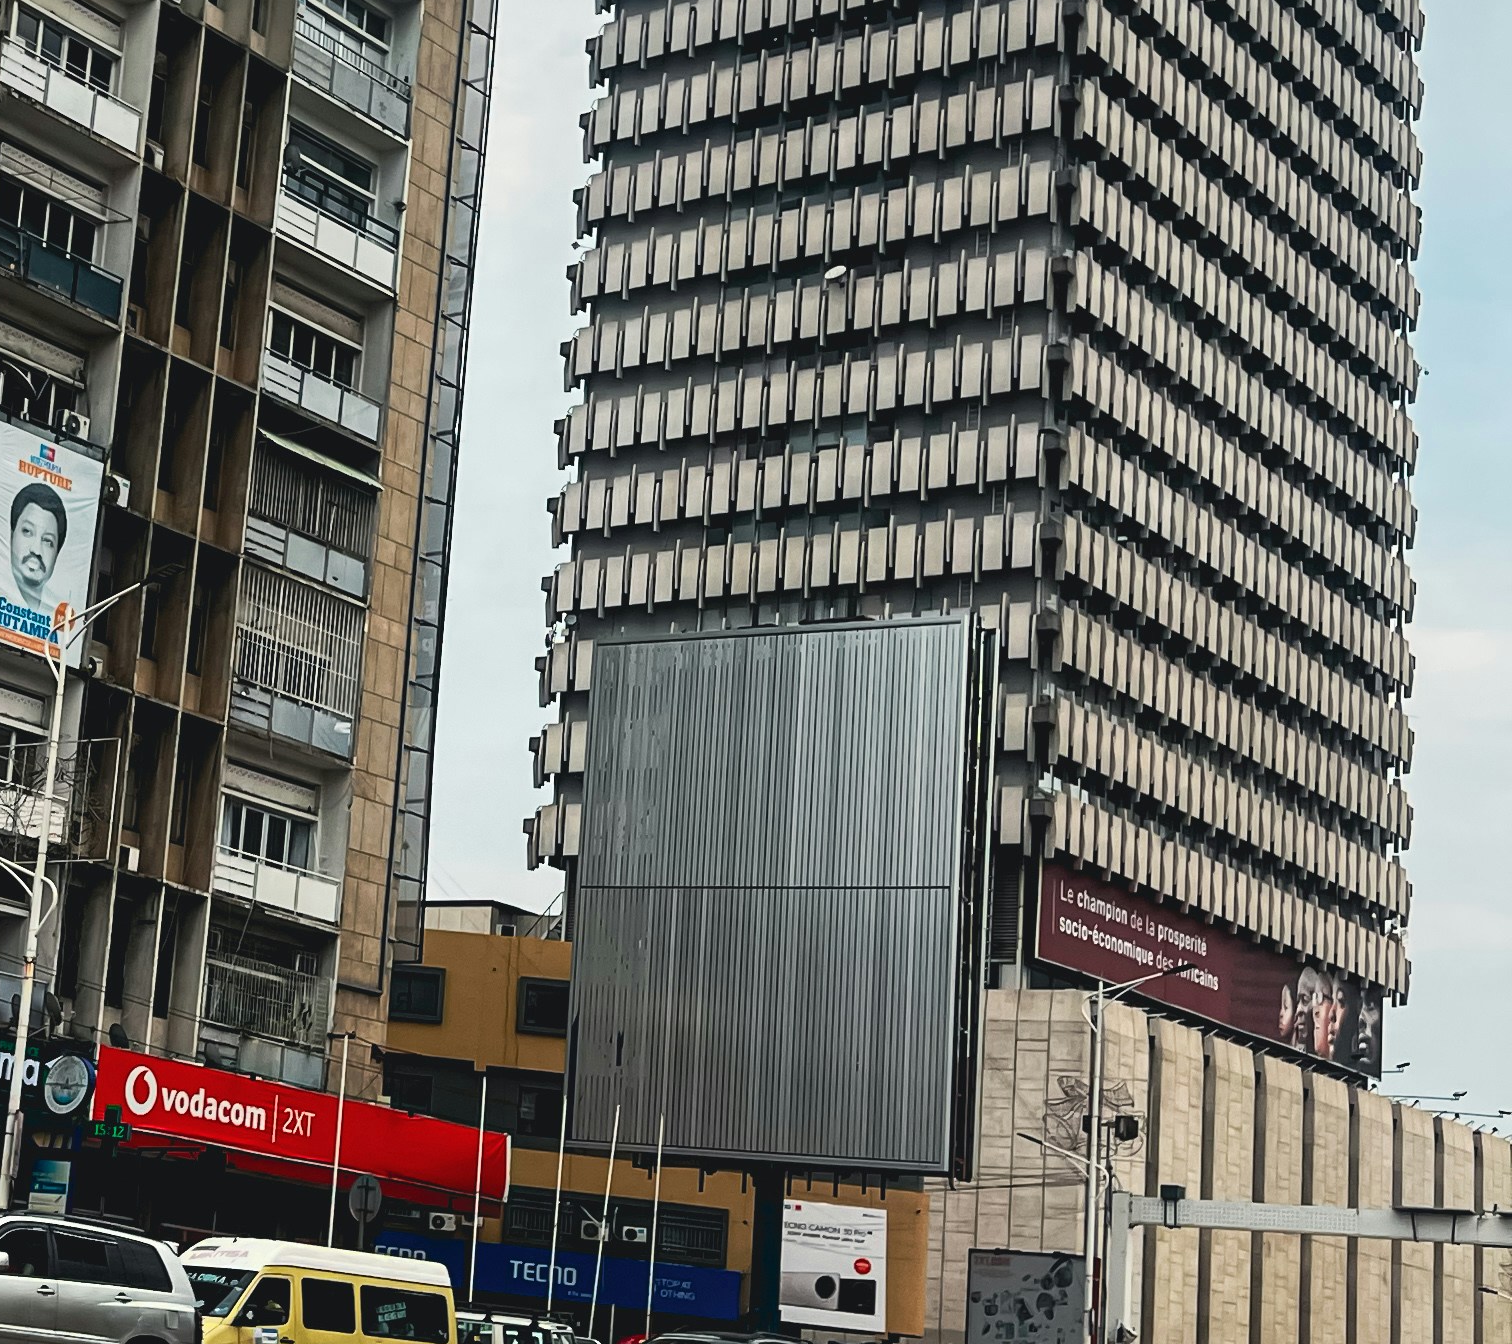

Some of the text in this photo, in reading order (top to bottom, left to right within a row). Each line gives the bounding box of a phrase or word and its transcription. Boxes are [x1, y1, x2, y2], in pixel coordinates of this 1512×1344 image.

[18, 459, 73, 492] RUPTURE
[1060, 879, 1074, 904] Le
[1077, 890, 1128, 925] champion
[1130, 910, 1143, 932] de
[1145, 914, 1156, 937] la
[1059, 916, 1154, 966] socio-économique
[1155, 950, 1174, 971] des
[160, 1086, 317, 1138] vodacom 2XT
[509, 1259, 577, 1287] TECNO
[654, 1284, 696, 1301] OTHING
